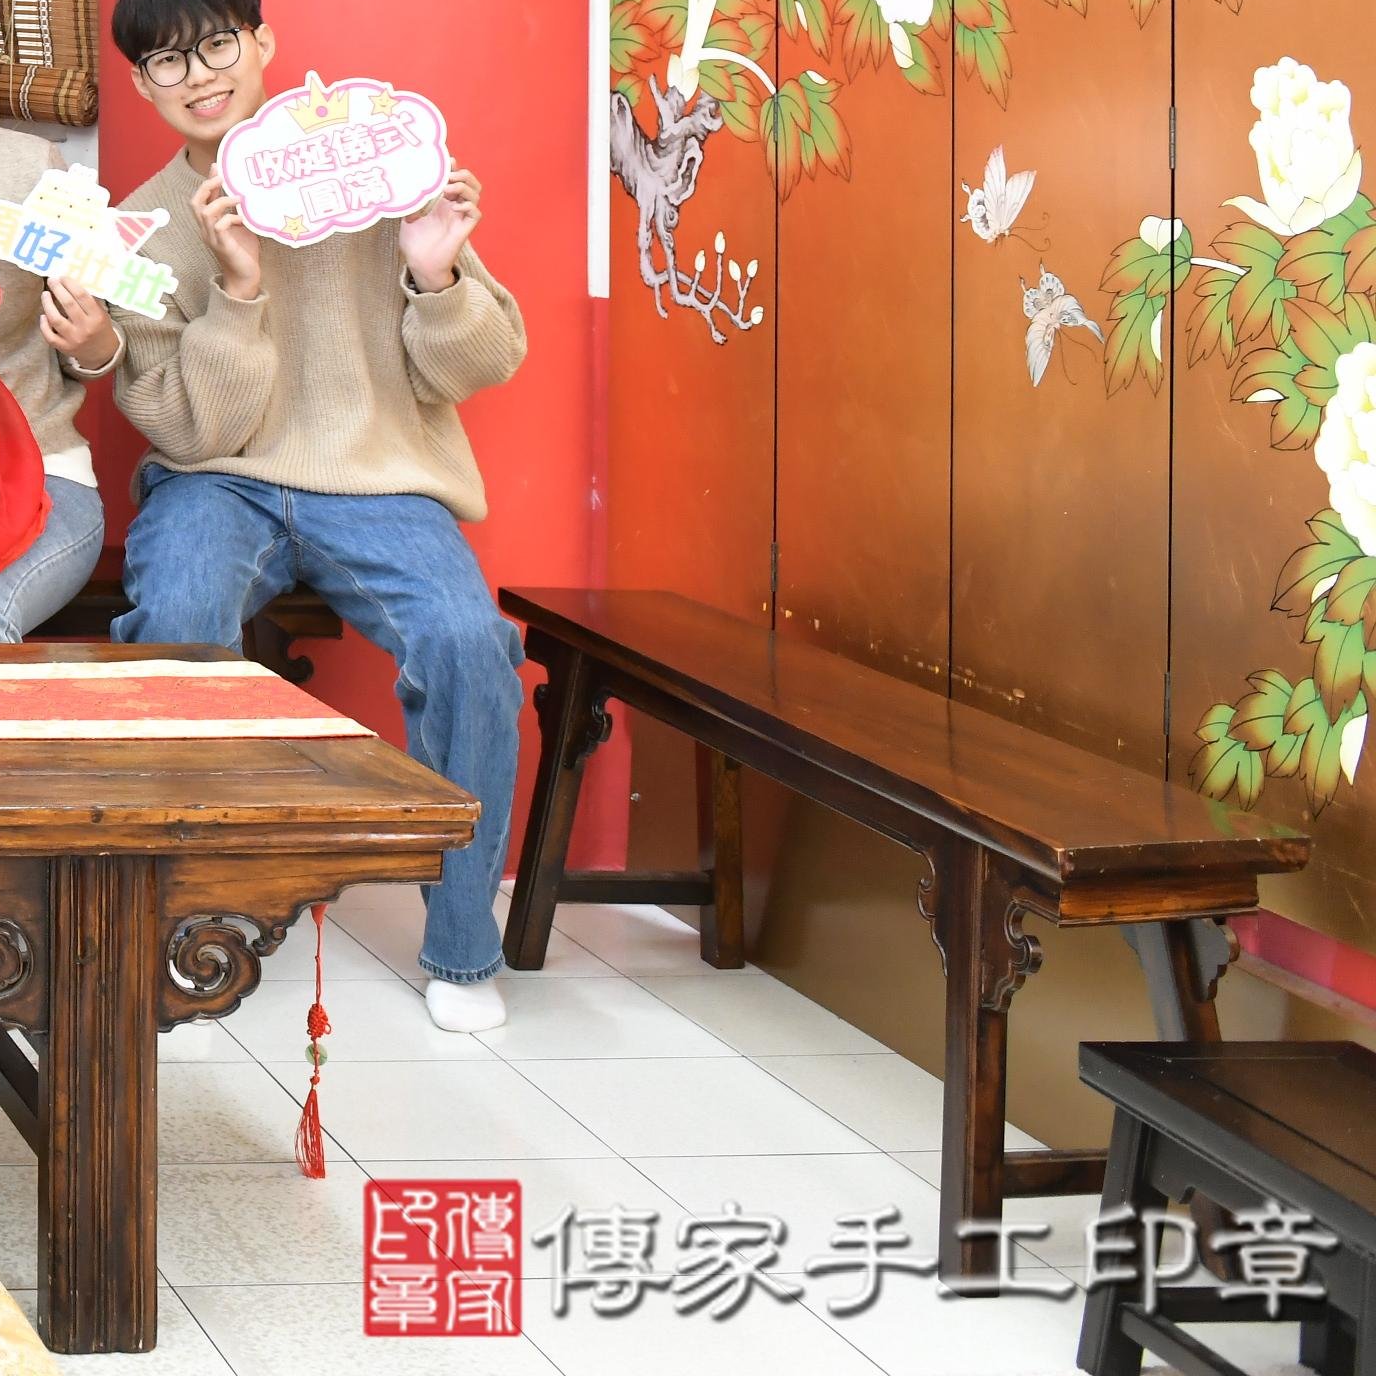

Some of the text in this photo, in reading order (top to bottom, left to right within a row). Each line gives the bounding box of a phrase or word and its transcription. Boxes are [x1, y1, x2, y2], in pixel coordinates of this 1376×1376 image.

[245, 111, 422, 188] 收涎儀式
[299, 167, 393, 224] 圓滿
